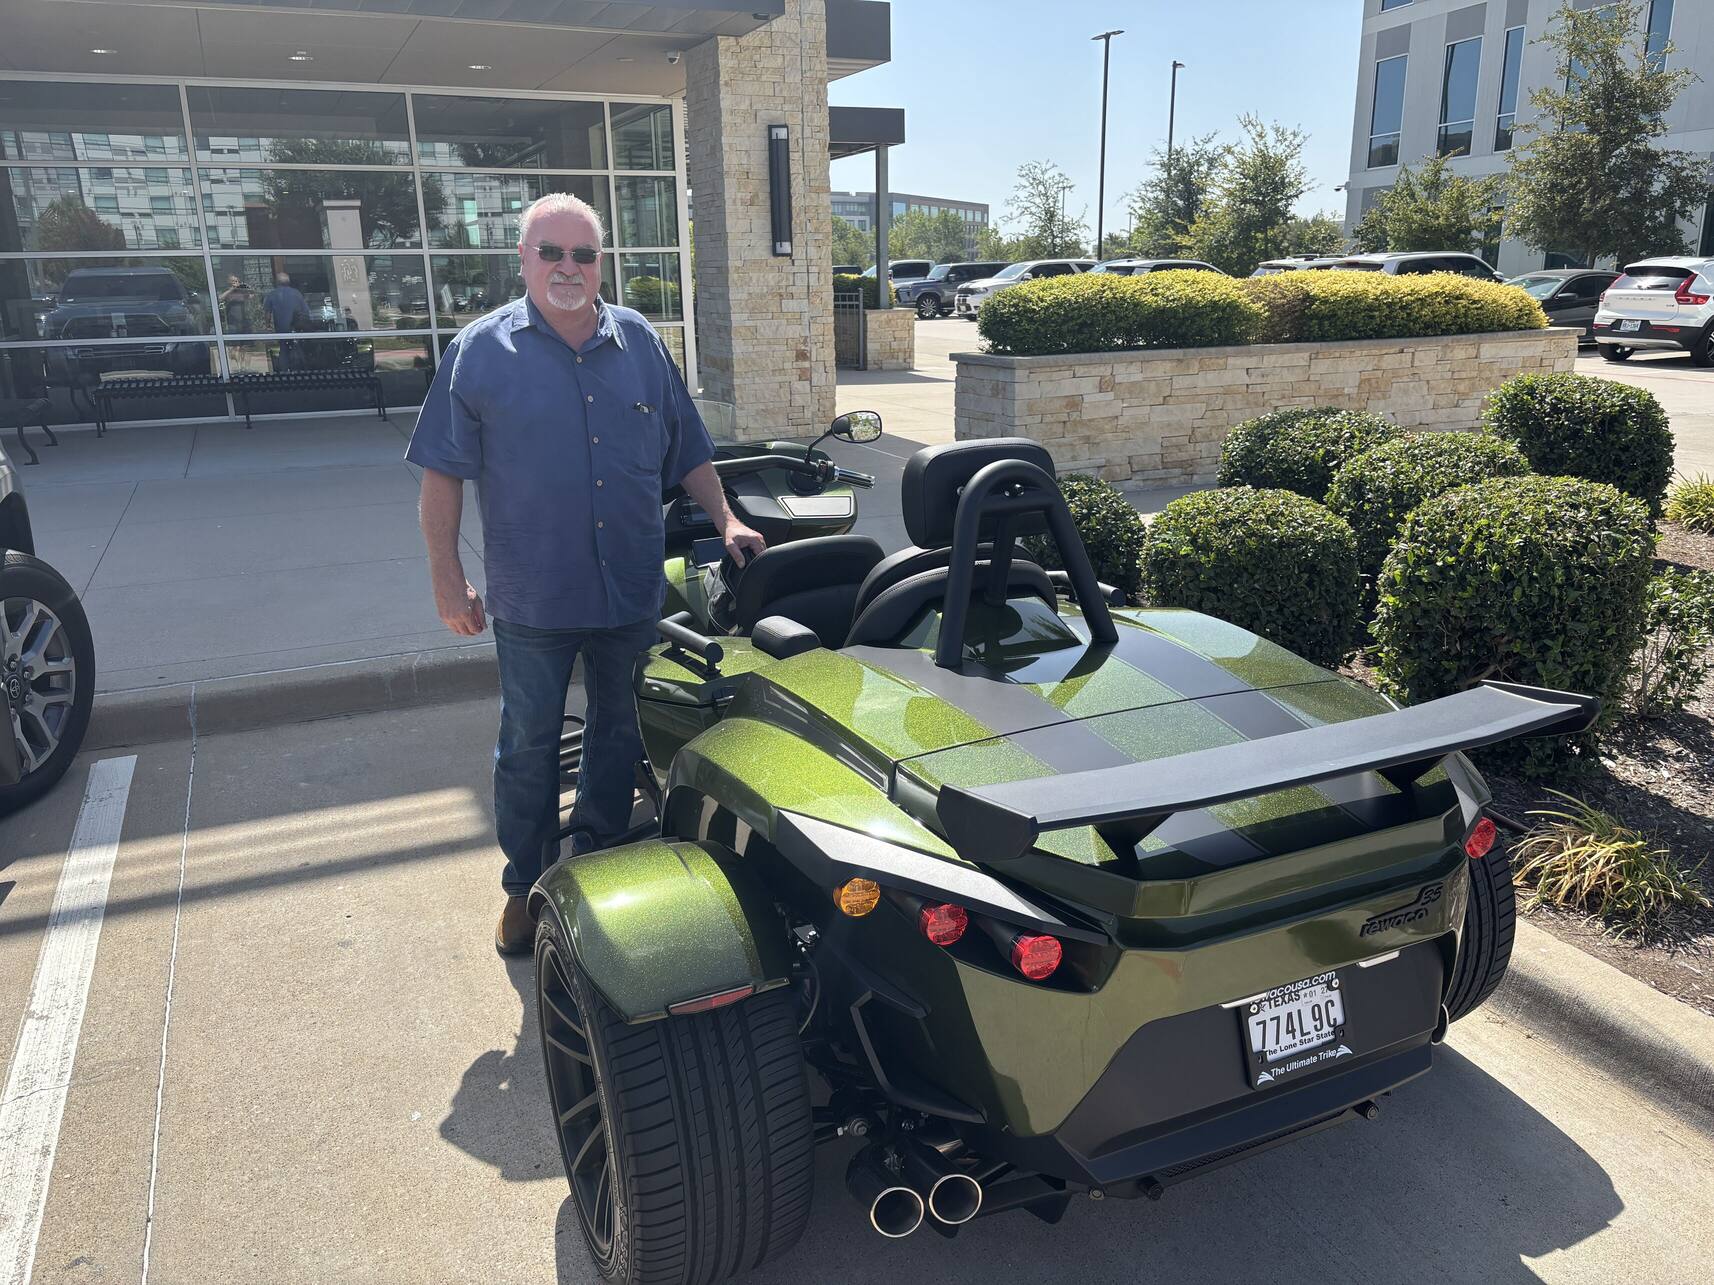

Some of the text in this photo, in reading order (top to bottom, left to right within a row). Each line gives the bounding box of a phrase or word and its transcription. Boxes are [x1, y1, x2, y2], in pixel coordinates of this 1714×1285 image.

[1360, 908, 1429, 937] rewaco
[1267, 991, 1300, 1009] TEXAS
[1256, 999, 1337, 1050] 774L9C
[1279, 1043, 1297, 1053] Lone
[1299, 1037, 1314, 1046] Star
[1317, 1030, 1335, 1041] State
[1271, 1049, 1337, 1077] The Ultimate Trike
